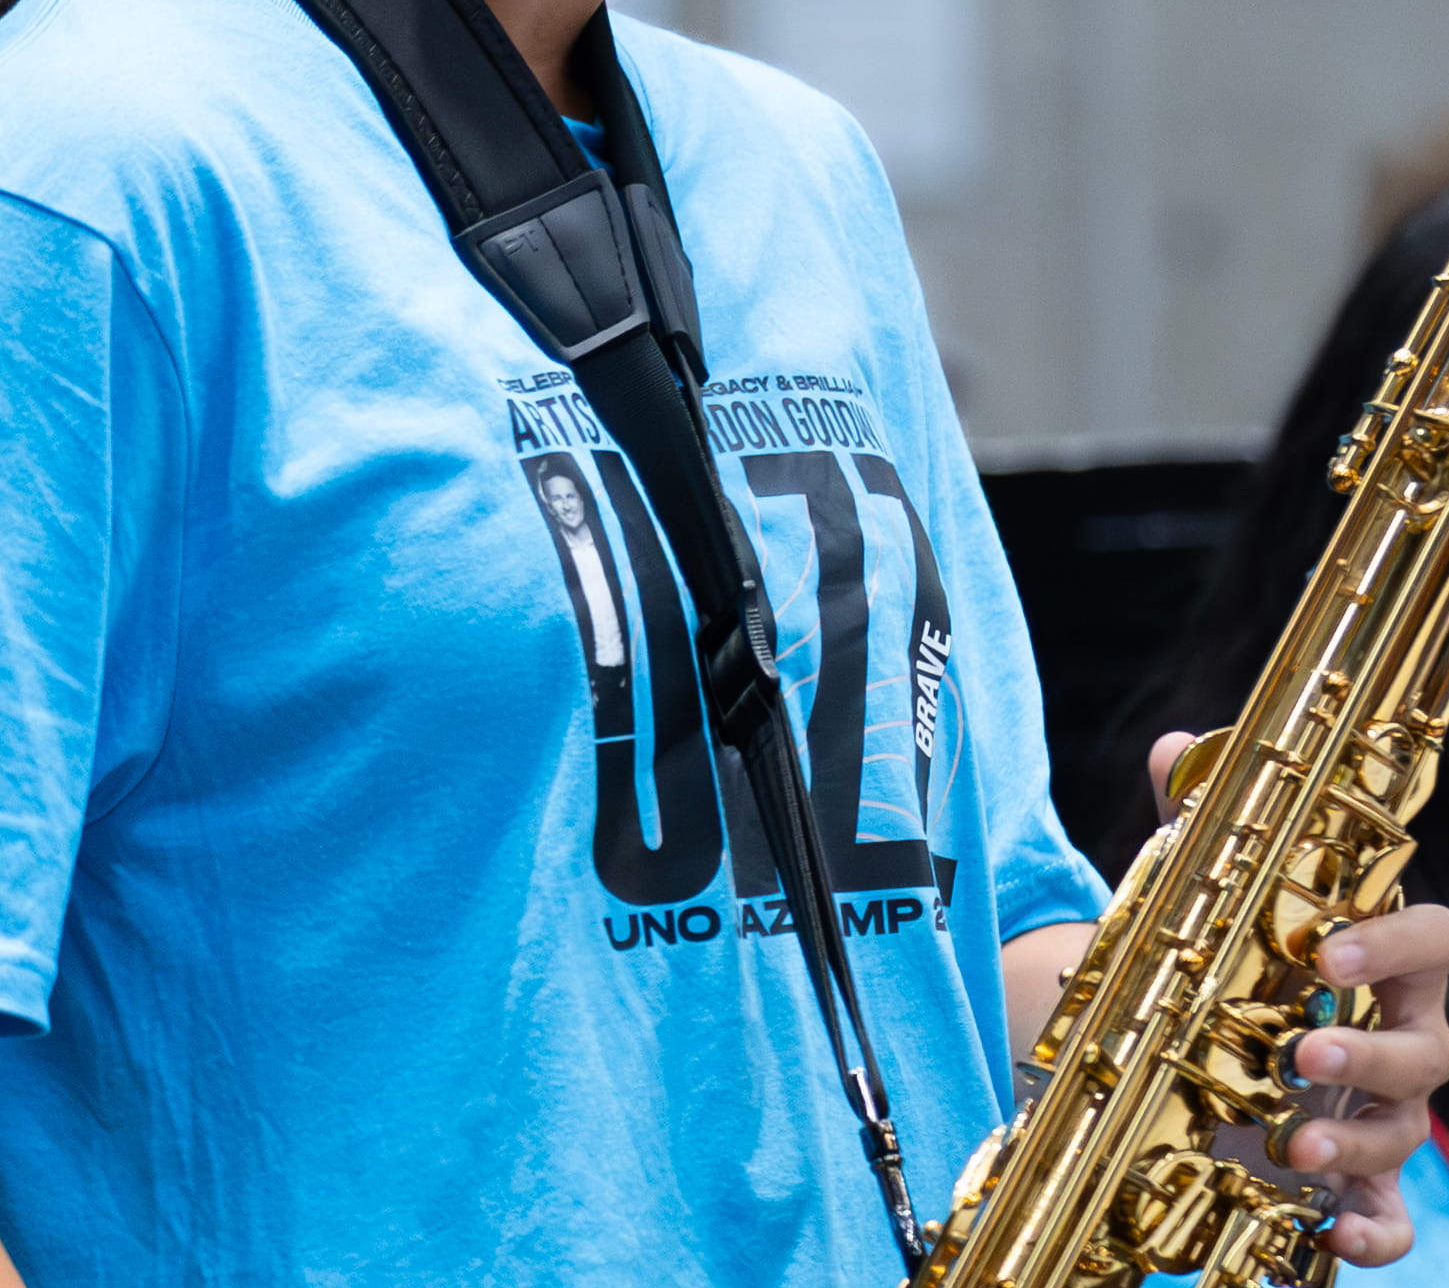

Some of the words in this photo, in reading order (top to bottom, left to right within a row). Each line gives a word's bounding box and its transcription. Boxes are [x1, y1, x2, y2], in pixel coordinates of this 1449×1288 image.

[776, 374, 794, 392] &
[506, 392, 604, 454] ARTIS
[912, 618, 952, 760] BRAVE
[603, 905, 722, 952] UNO
[839, 897, 924, 938] MP
